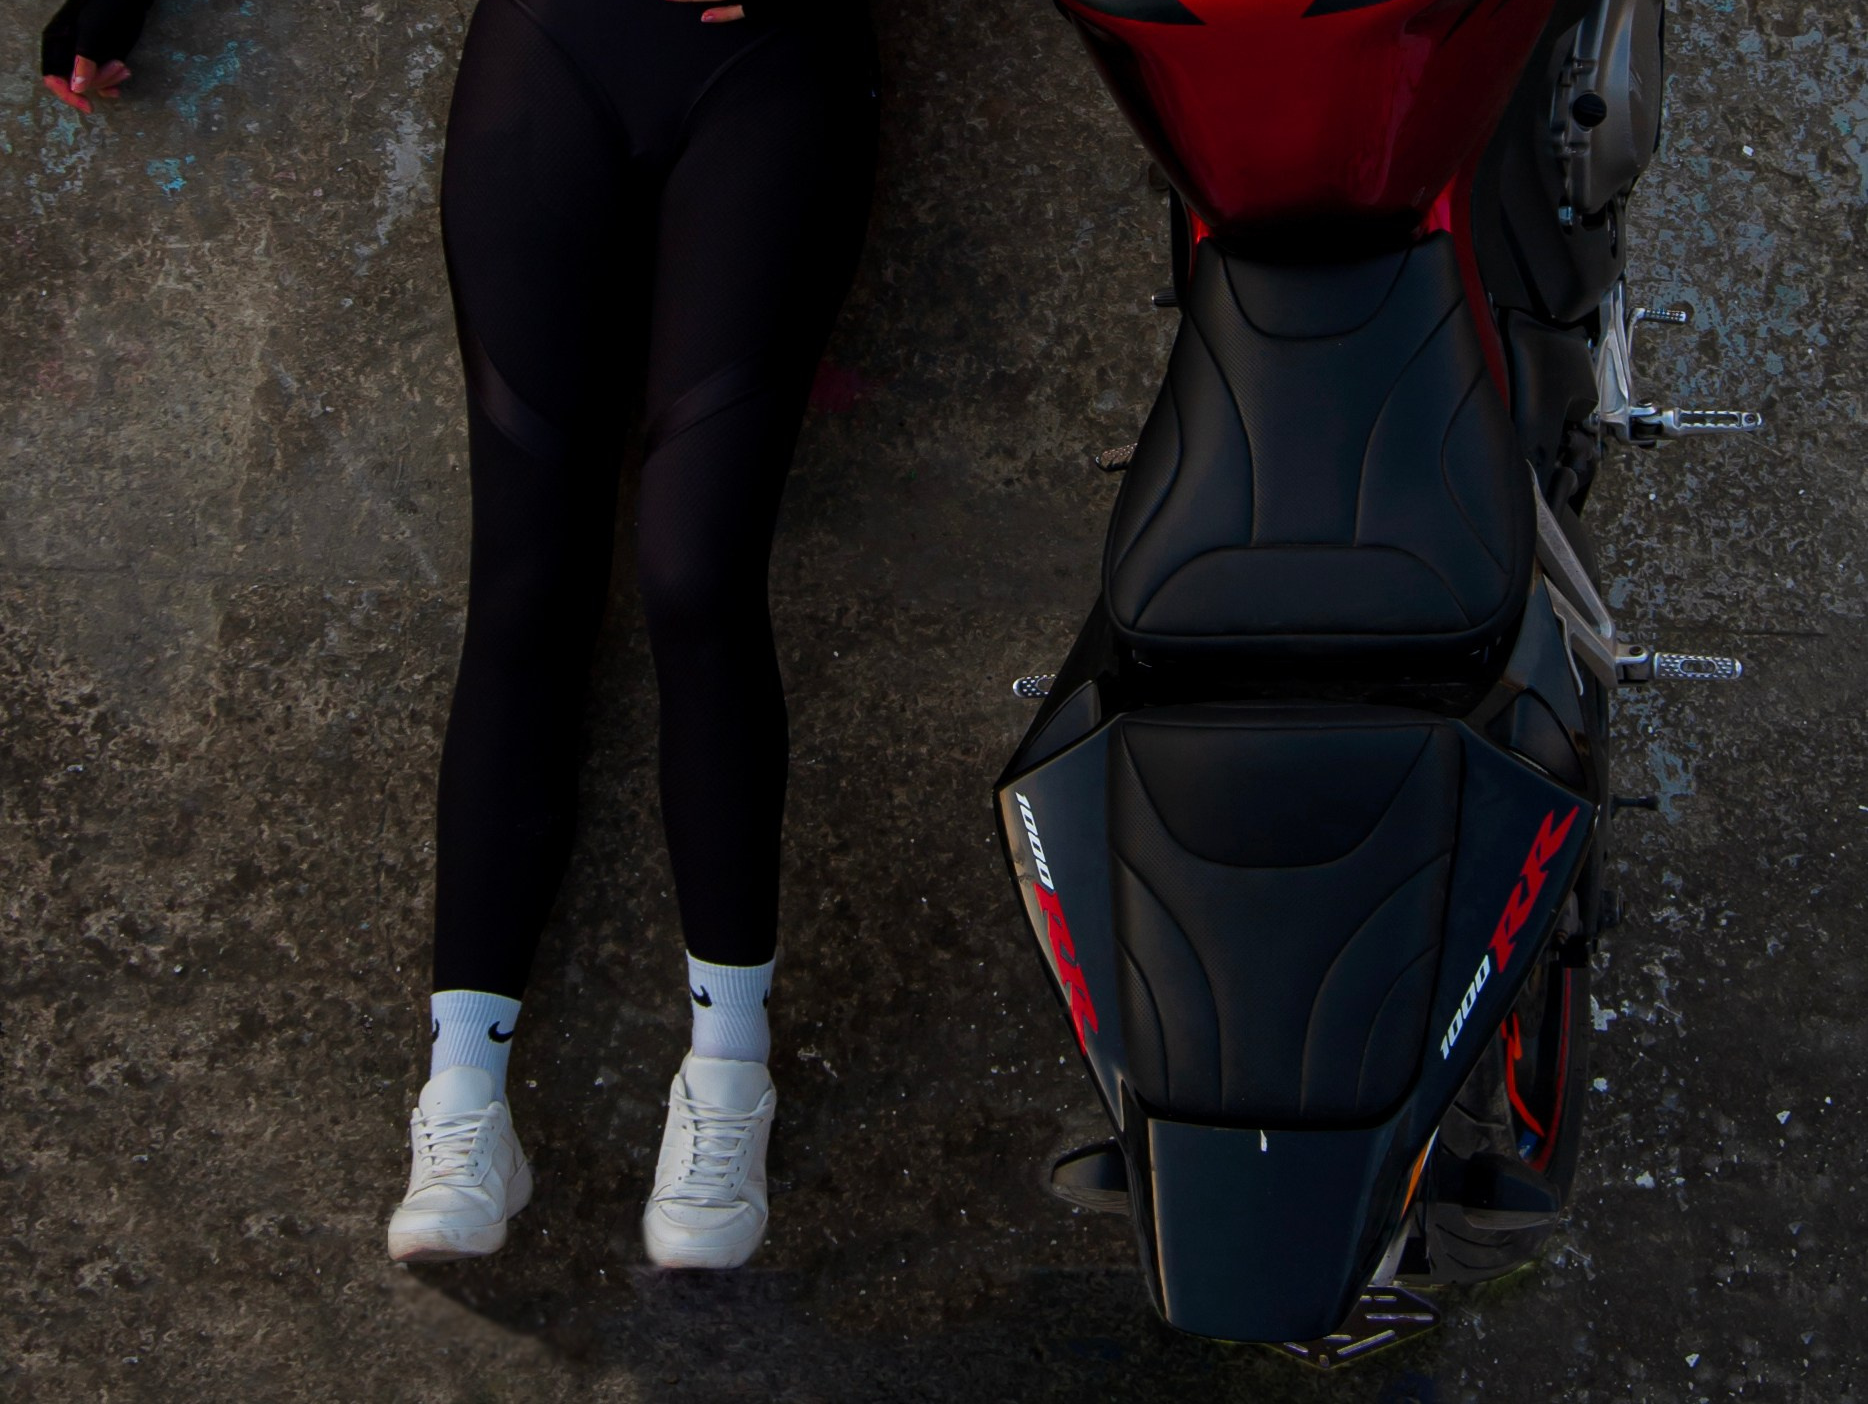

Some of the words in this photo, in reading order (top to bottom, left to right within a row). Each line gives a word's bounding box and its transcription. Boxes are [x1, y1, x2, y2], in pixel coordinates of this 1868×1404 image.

[1014, 791, 1056, 892] 1000
[1440, 953, 1492, 1061] 1000
[1488, 804, 1581, 975] RR
